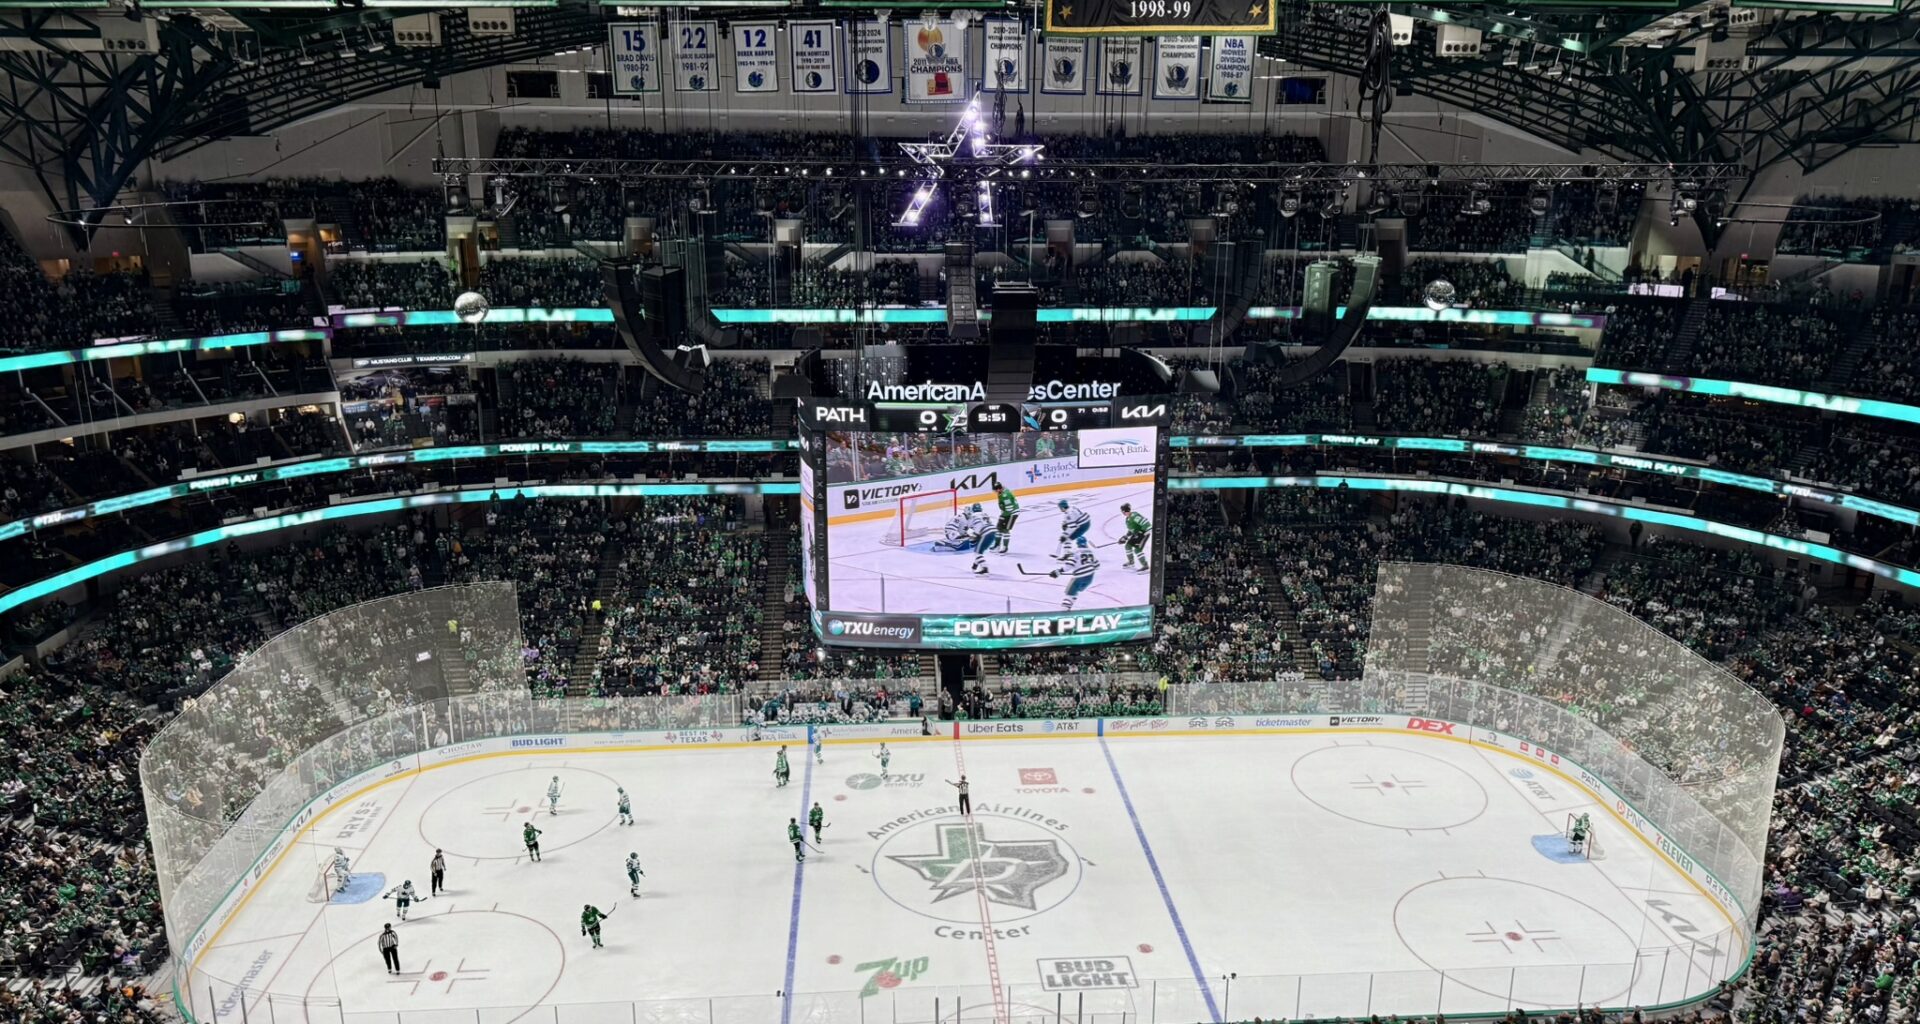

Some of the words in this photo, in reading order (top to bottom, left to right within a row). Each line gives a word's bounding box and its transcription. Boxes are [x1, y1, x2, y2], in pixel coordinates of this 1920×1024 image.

[1130, 1, 1191, 18] 1998-99
[622, 30, 646, 51] 15
[682, 27, 706, 48] 22
[744, 29, 766, 48] 12
[803, 30, 821, 48] 41
[1224, 39, 1244, 48] NBA
[852, 46, 882, 54] AMPIONS
[1049, 45, 1082, 53] CHAMPIONS
[617, 54, 634, 62] BRAD
[913, 58, 927, 66] 2011
[1220, 56, 1246, 64] DIVISION
[624, 64, 650, 72] 1980-92
[682, 62, 708, 71] 1981-92
[910, 64, 962, 73] CHAMPIONS
[1216, 64, 1250, 72] CHAMPIONS
[816, 408, 866, 422] PATH
[920, 410, 937, 424] 0
[978, 413, 1006, 422] 5:51
[1051, 409, 1067, 423] 0
[1122, 404, 1165, 418] KIA
[1322, 435, 1355, 444] POWER
[1355, 436, 1380, 445] PLAY
[500, 443, 540, 452] POWER
[542, 443, 570, 451] PLAY
[1611, 455, 1652, 469] POWER
[1654, 462, 1687, 475] PLAY
[190, 476, 229, 489] POWER
[231, 474, 258, 485] PLAY
[950, 472, 997, 490] KIA
[954, 618, 1050, 637] POWER
[1057, 614, 1122, 634] PLAY
[968, 724, 994, 733] Uber
[996, 723, 1023, 733] Eats
[1056, 722, 1079, 730] AT&T
[1256, 718, 1312, 727] ticketmaster
[1406, 718, 1456, 735] DEX
[535, 738, 564, 746] LIGHT
[1581, 771, 1600, 791] PATH
[866, 804, 960, 840] American
[975, 802, 1070, 832] Airlines
[1626, 809, 1646, 833] PNC
[1655, 833, 1694, 874] 7-ELEVEN
[934, 924, 1031, 940] Center
[1054, 960, 1114, 974] BUD
[1048, 972, 1128, 987] LIGHT
